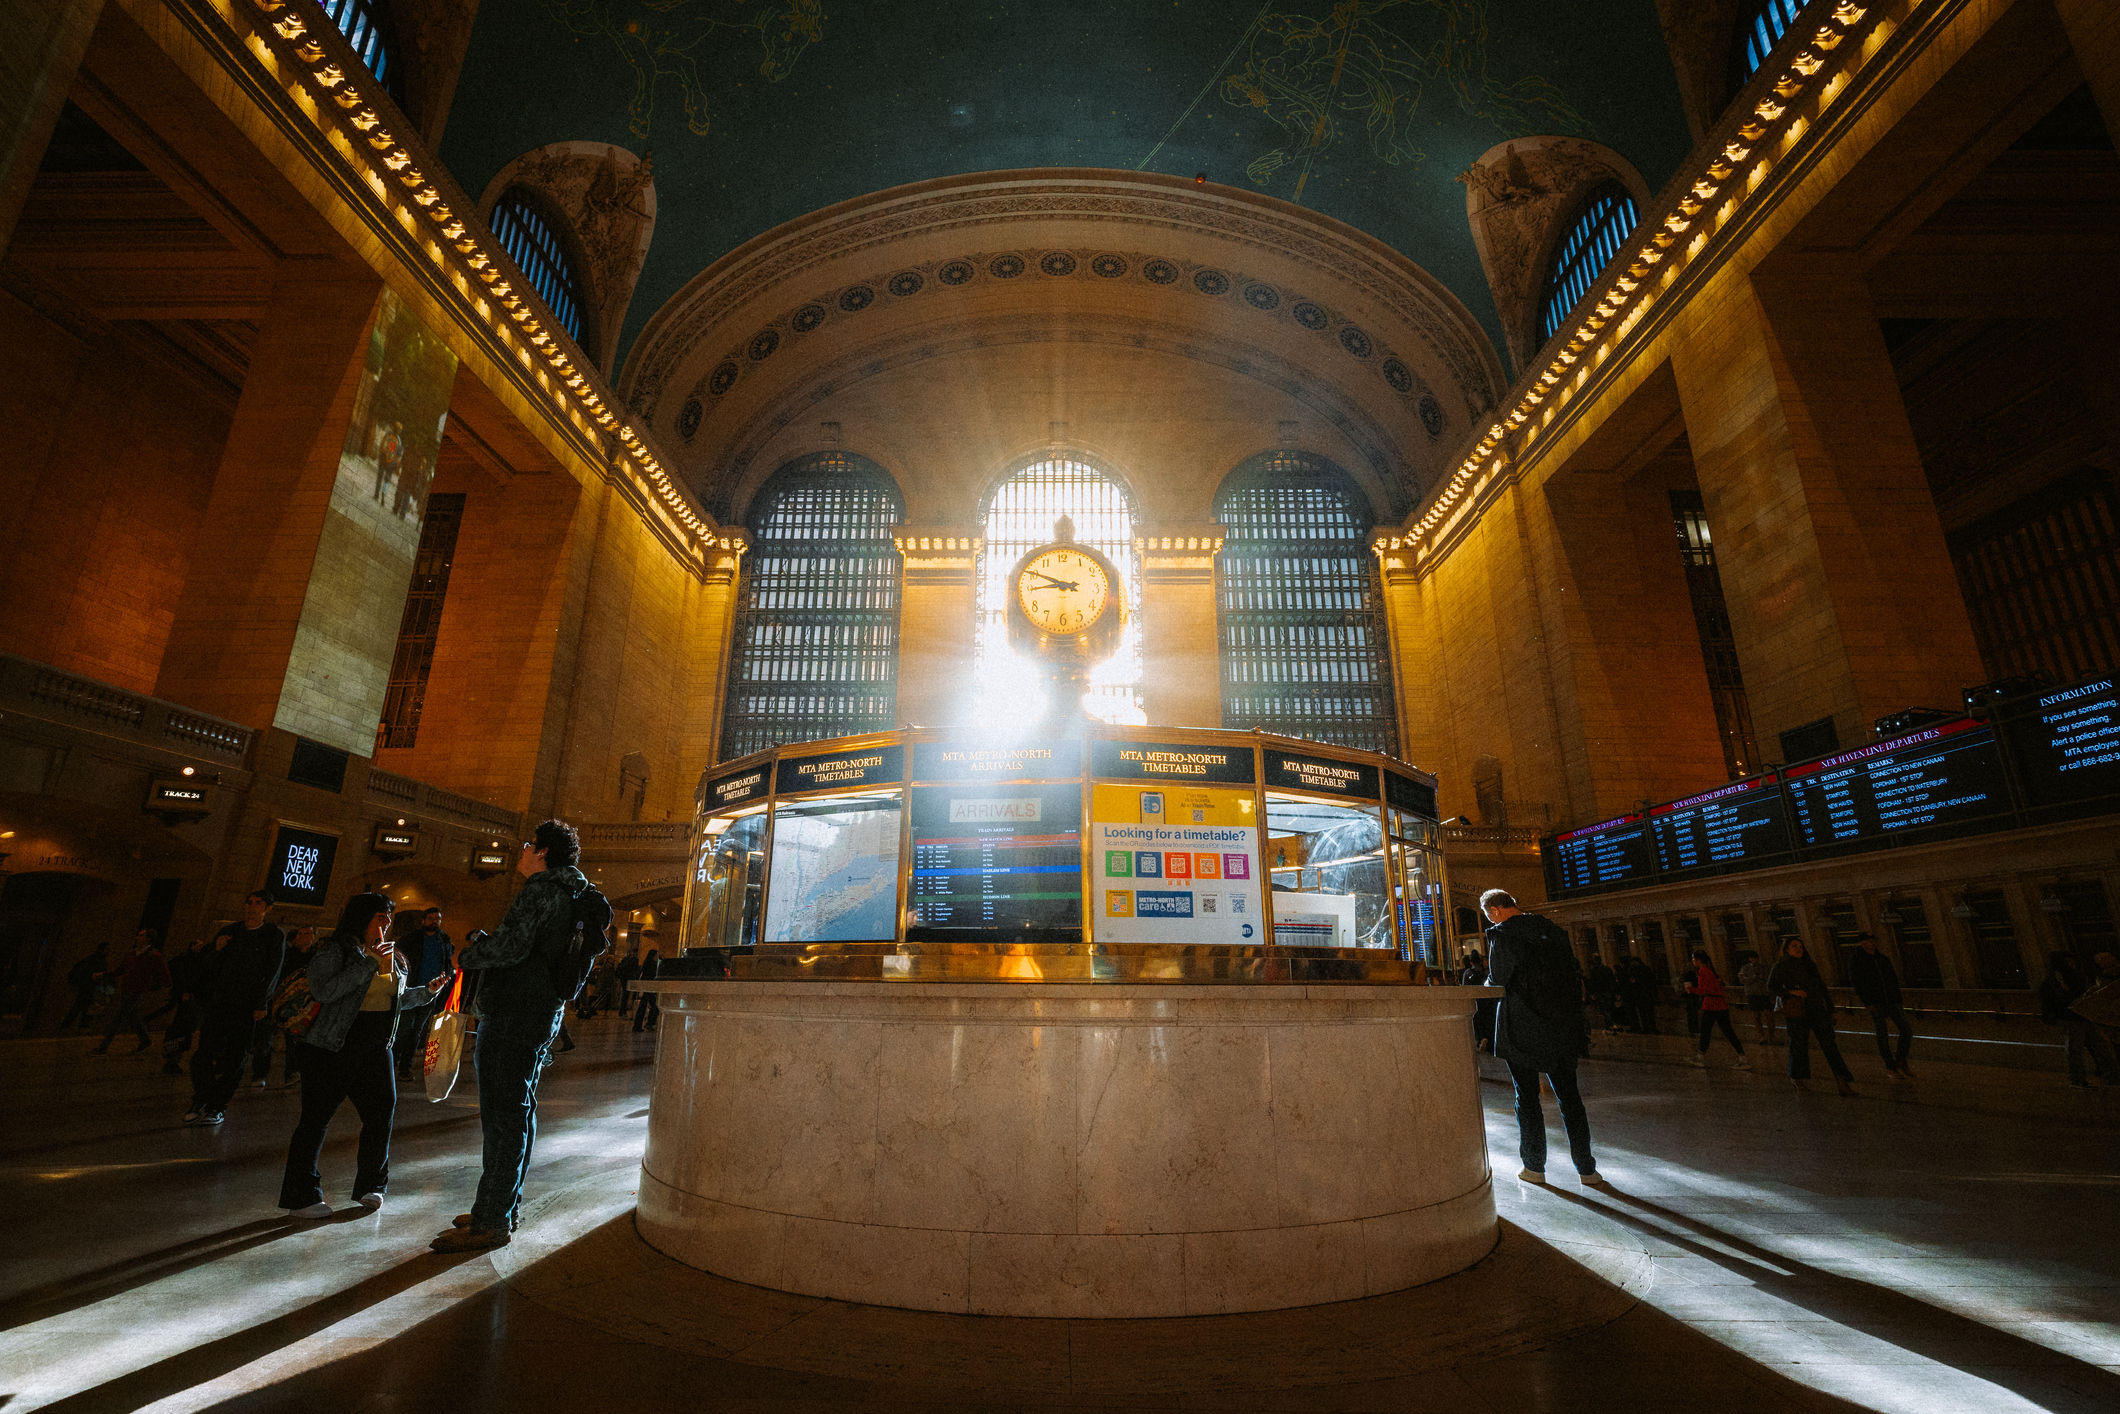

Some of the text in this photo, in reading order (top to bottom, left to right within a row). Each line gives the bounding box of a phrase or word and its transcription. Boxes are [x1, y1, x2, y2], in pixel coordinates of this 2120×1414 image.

[1042, 558, 1049, 568] 11
[1058, 554, 1067, 562] 12
[1088, 567, 1095, 577] 2
[1092, 583, 1099, 594] 3
[1032, 600, 1038, 612] 8
[1088, 599, 1096, 611] 4
[1044, 610, 1050, 622] 7
[1060, 613, 1067, 626] 6
[1076, 610, 1083, 622] 5
[2040, 680, 2112, 706] INFORMATION
[2049, 714, 2062, 723] you
[2063, 710, 2076, 718] see
[2052, 737, 2068, 747] Alert
[2075, 731, 2097, 743] police
[942, 749, 1052, 761] MTA METRO-NORTH
[1821, 728, 1940, 768] NEW HAVEN LINE DEPARTURES
[2064, 740, 2119, 757] MTA employee
[1120, 750, 1227, 764] MTA METRO-NORTH
[798, 756, 882, 774] MTA METRO-NORTH
[970, 761, 1023, 771] ARRIVALS
[1142, 762, 1206, 774] TIMETABLES
[1283, 760, 1360, 780] MTA METRO-NORTH
[1821, 768, 1856, 782] DESTINATION
[1867, 758, 1894, 770] REMARKS
[2068, 760, 2081, 769] call
[814, 769, 864, 782] TIMETABLES
[1834, 780, 1849, 788] HAVEN
[1870, 767, 1901, 779] CONNECTION
[1910, 761, 1922, 769] NEW
[1923, 756, 1945, 766] CANAAN
[716, 774, 761, 794] MTA METRO-NORTH
[1300, 774, 1346, 788] TIMETABLES
[1826, 790, 1850, 800] STAMFORD
[1872, 779, 1896, 789] FORDHAM
[1910, 772, 1924, 780] STOP
[164, 790, 190, 798] TRACK
[724, 786, 751, 801] TIMETABLES
[1673, 801, 1683, 810] NEW
[1714, 783, 1748, 798] DEPARTURES
[1839, 799, 1854, 807] HAVEN
[1875, 787, 1907, 799] CONNECTION
[1915, 778, 1948, 790] WATERBURY
[955, 803, 1036, 818] ARRIVALS
[1830, 809, 1854, 819] STAMFORD
[1877, 799, 1902, 809] FORDHAM
[1915, 793, 1929, 802] STOP
[1832, 821, 1843, 829] NEW
[1880, 808, 1912, 819] CONNECTION
[1921, 801, 1948, 812] DANBURY,
[1948, 798, 1960, 806] NEW
[1961, 793, 1986, 803] CANAAN
[1835, 829, 1859, 838] STAMFORD
[1882, 819, 1907, 829] FORDHAM
[1921, 814, 1935, 823] STOP
[1105, 827, 1246, 841] Looking for a timetable?
[288, 844, 319, 862] DEAR
[54, 857, 88, 868] TRACK
[286, 859, 316, 875] NEW
[283, 872, 314, 891] YORK,
[635, 878, 668, 890] TRACKS
[1139, 902, 1159, 911] care
